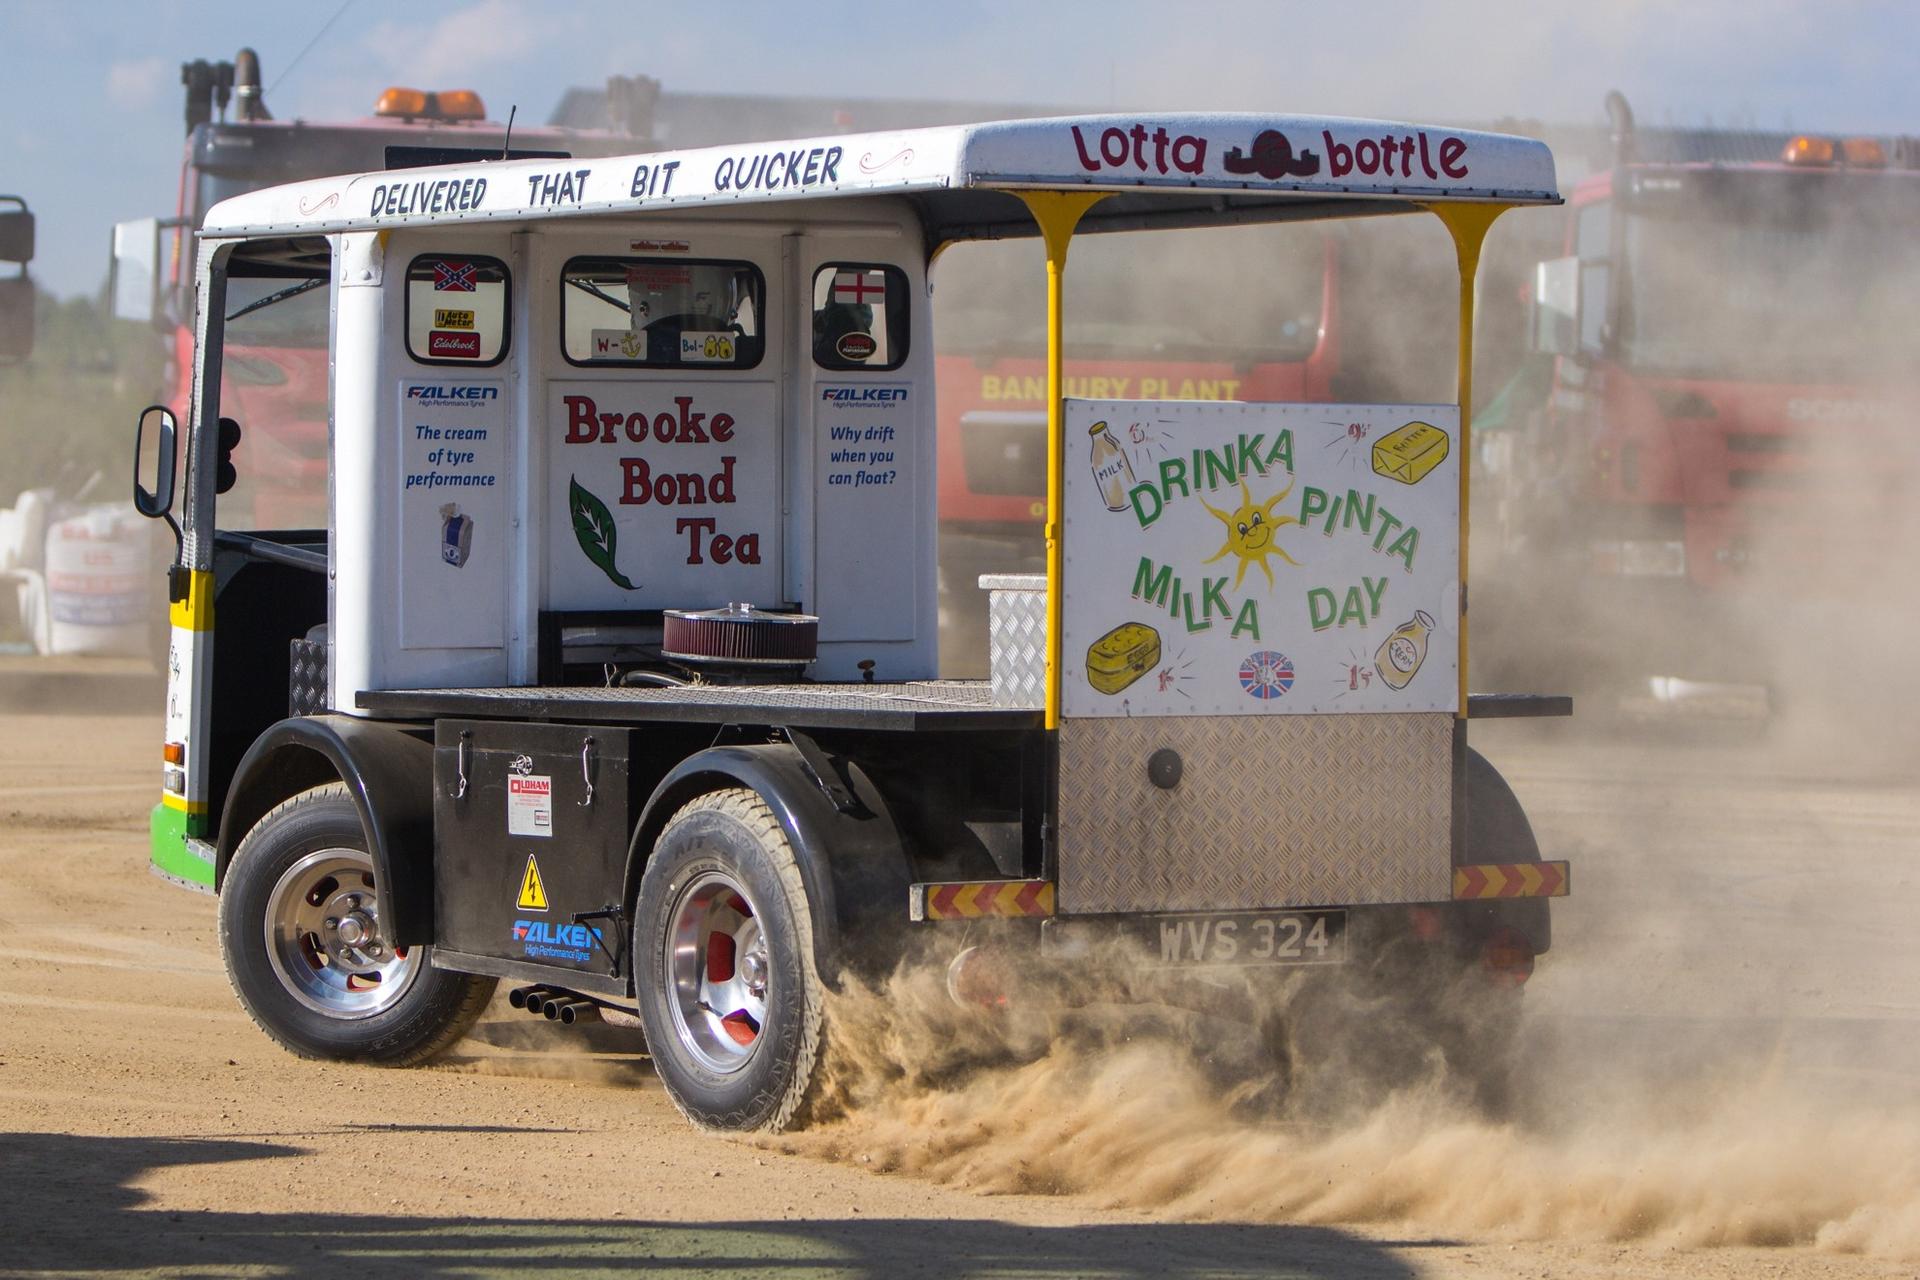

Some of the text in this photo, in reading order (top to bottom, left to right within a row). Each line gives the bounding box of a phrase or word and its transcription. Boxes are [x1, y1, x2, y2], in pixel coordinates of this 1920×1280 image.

[1071, 123, 1468, 179] Lotta bottle
[370, 146, 845, 218] DELIVERED THAT BIT QUICKER
[433, 337, 476, 350] Edelbrock
[407, 386, 498, 399] FALKEN
[822, 389, 908, 401] FALKEN
[981, 375, 1240, 400] BANURY PLANT
[563, 395, 736, 444] Brooke
[416, 425, 488, 441] The cream
[830, 426, 895, 444] Why drift
[428, 448, 475, 466] of tyre
[830, 448, 895, 466] when you
[405, 471, 496, 489] performance
[619, 456, 736, 505] Bond
[828, 470, 896, 488] can float?
[1098, 459, 1125, 481] MILK
[1127, 428, 1421, 575] DRINKA PINTA
[676, 517, 761, 565] Tea
[1131, 556, 1389, 644] MILKA DAY
[512, 919, 603, 950] FALKEN
[1159, 916, 1329, 962] WVS 324
